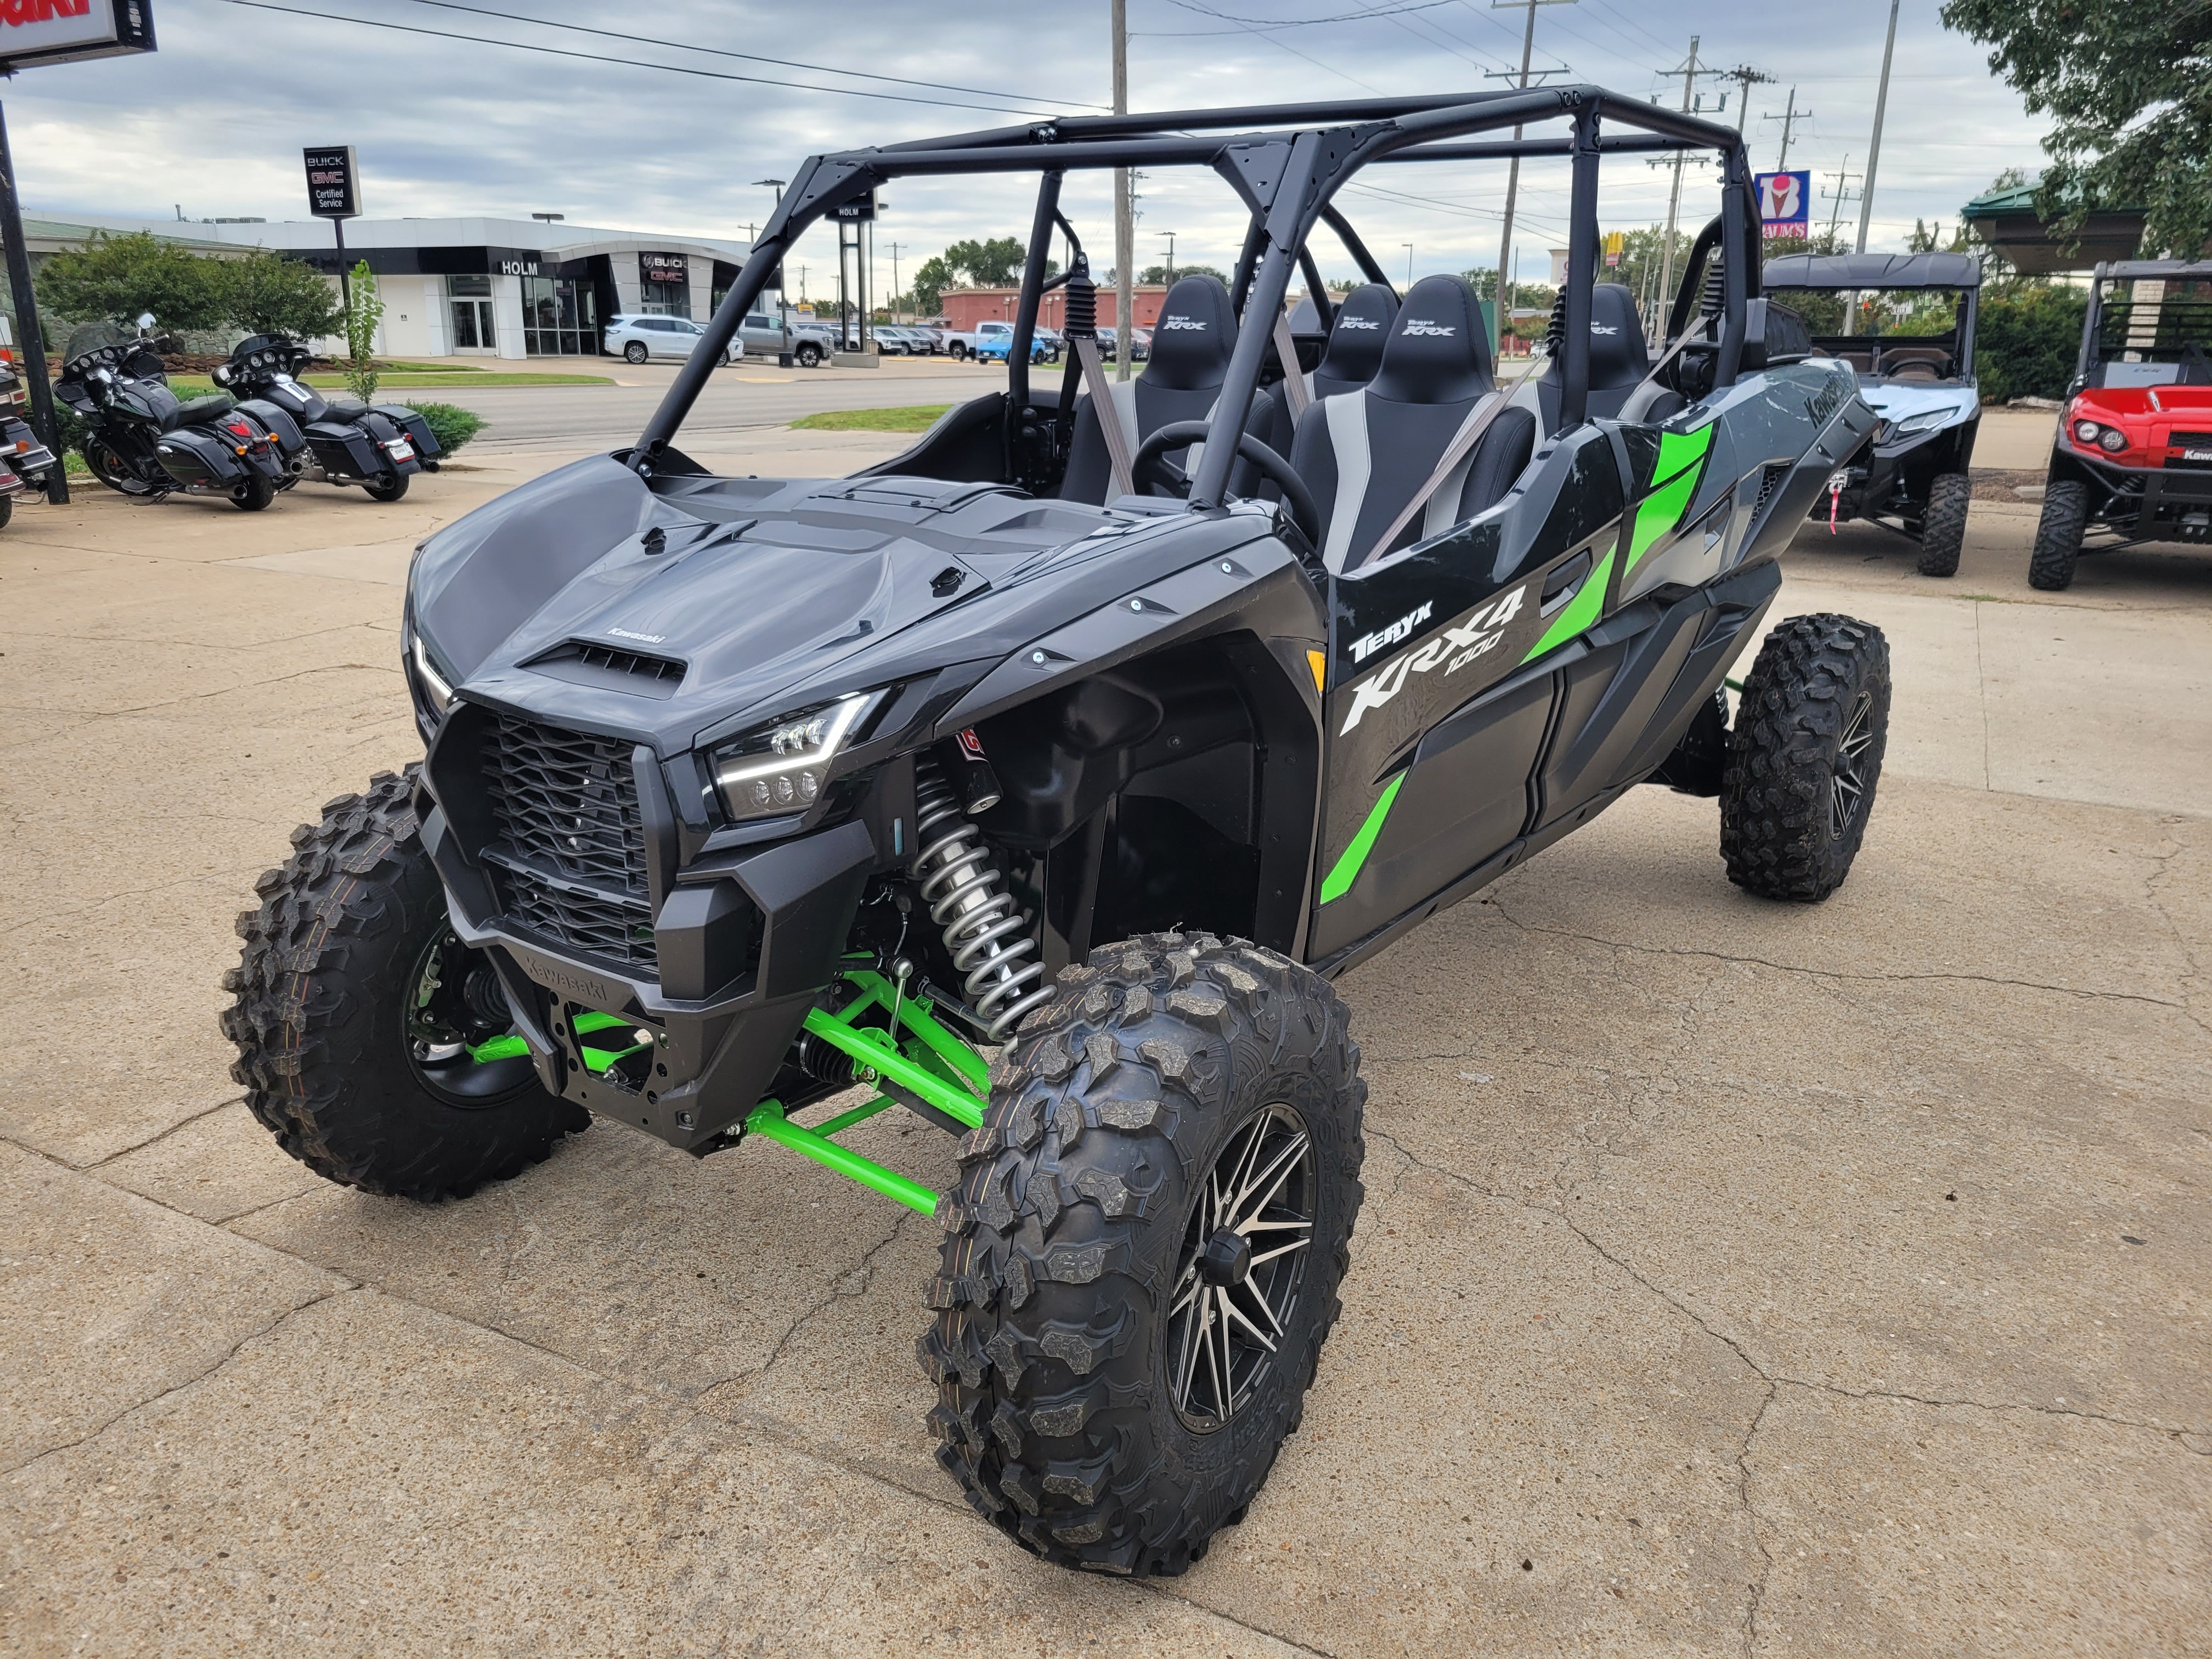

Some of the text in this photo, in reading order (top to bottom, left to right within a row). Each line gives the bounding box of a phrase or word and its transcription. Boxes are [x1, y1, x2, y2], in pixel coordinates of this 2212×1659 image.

[307, 156, 345, 167] BUICK
[311, 171, 345, 184] GMC
[316, 188, 344, 199] Certified
[319, 199, 343, 208] Service
[839, 208, 859, 216] HOLM
[654, 257, 687, 268] BUICK
[502, 261, 538, 276] HOLM
[650, 271, 683, 283] GMC
[1163, 321, 1207, 330] KRX
[1339, 321, 1381, 330] KRX
[1401, 326, 1457, 336] KRX
[2184, 449, 2212, 461] Kaw
[606, 627, 667, 644] Kawasaki
[1443, 628, 1505, 678] 1000
[525, 956, 607, 1001] Kawasaki
